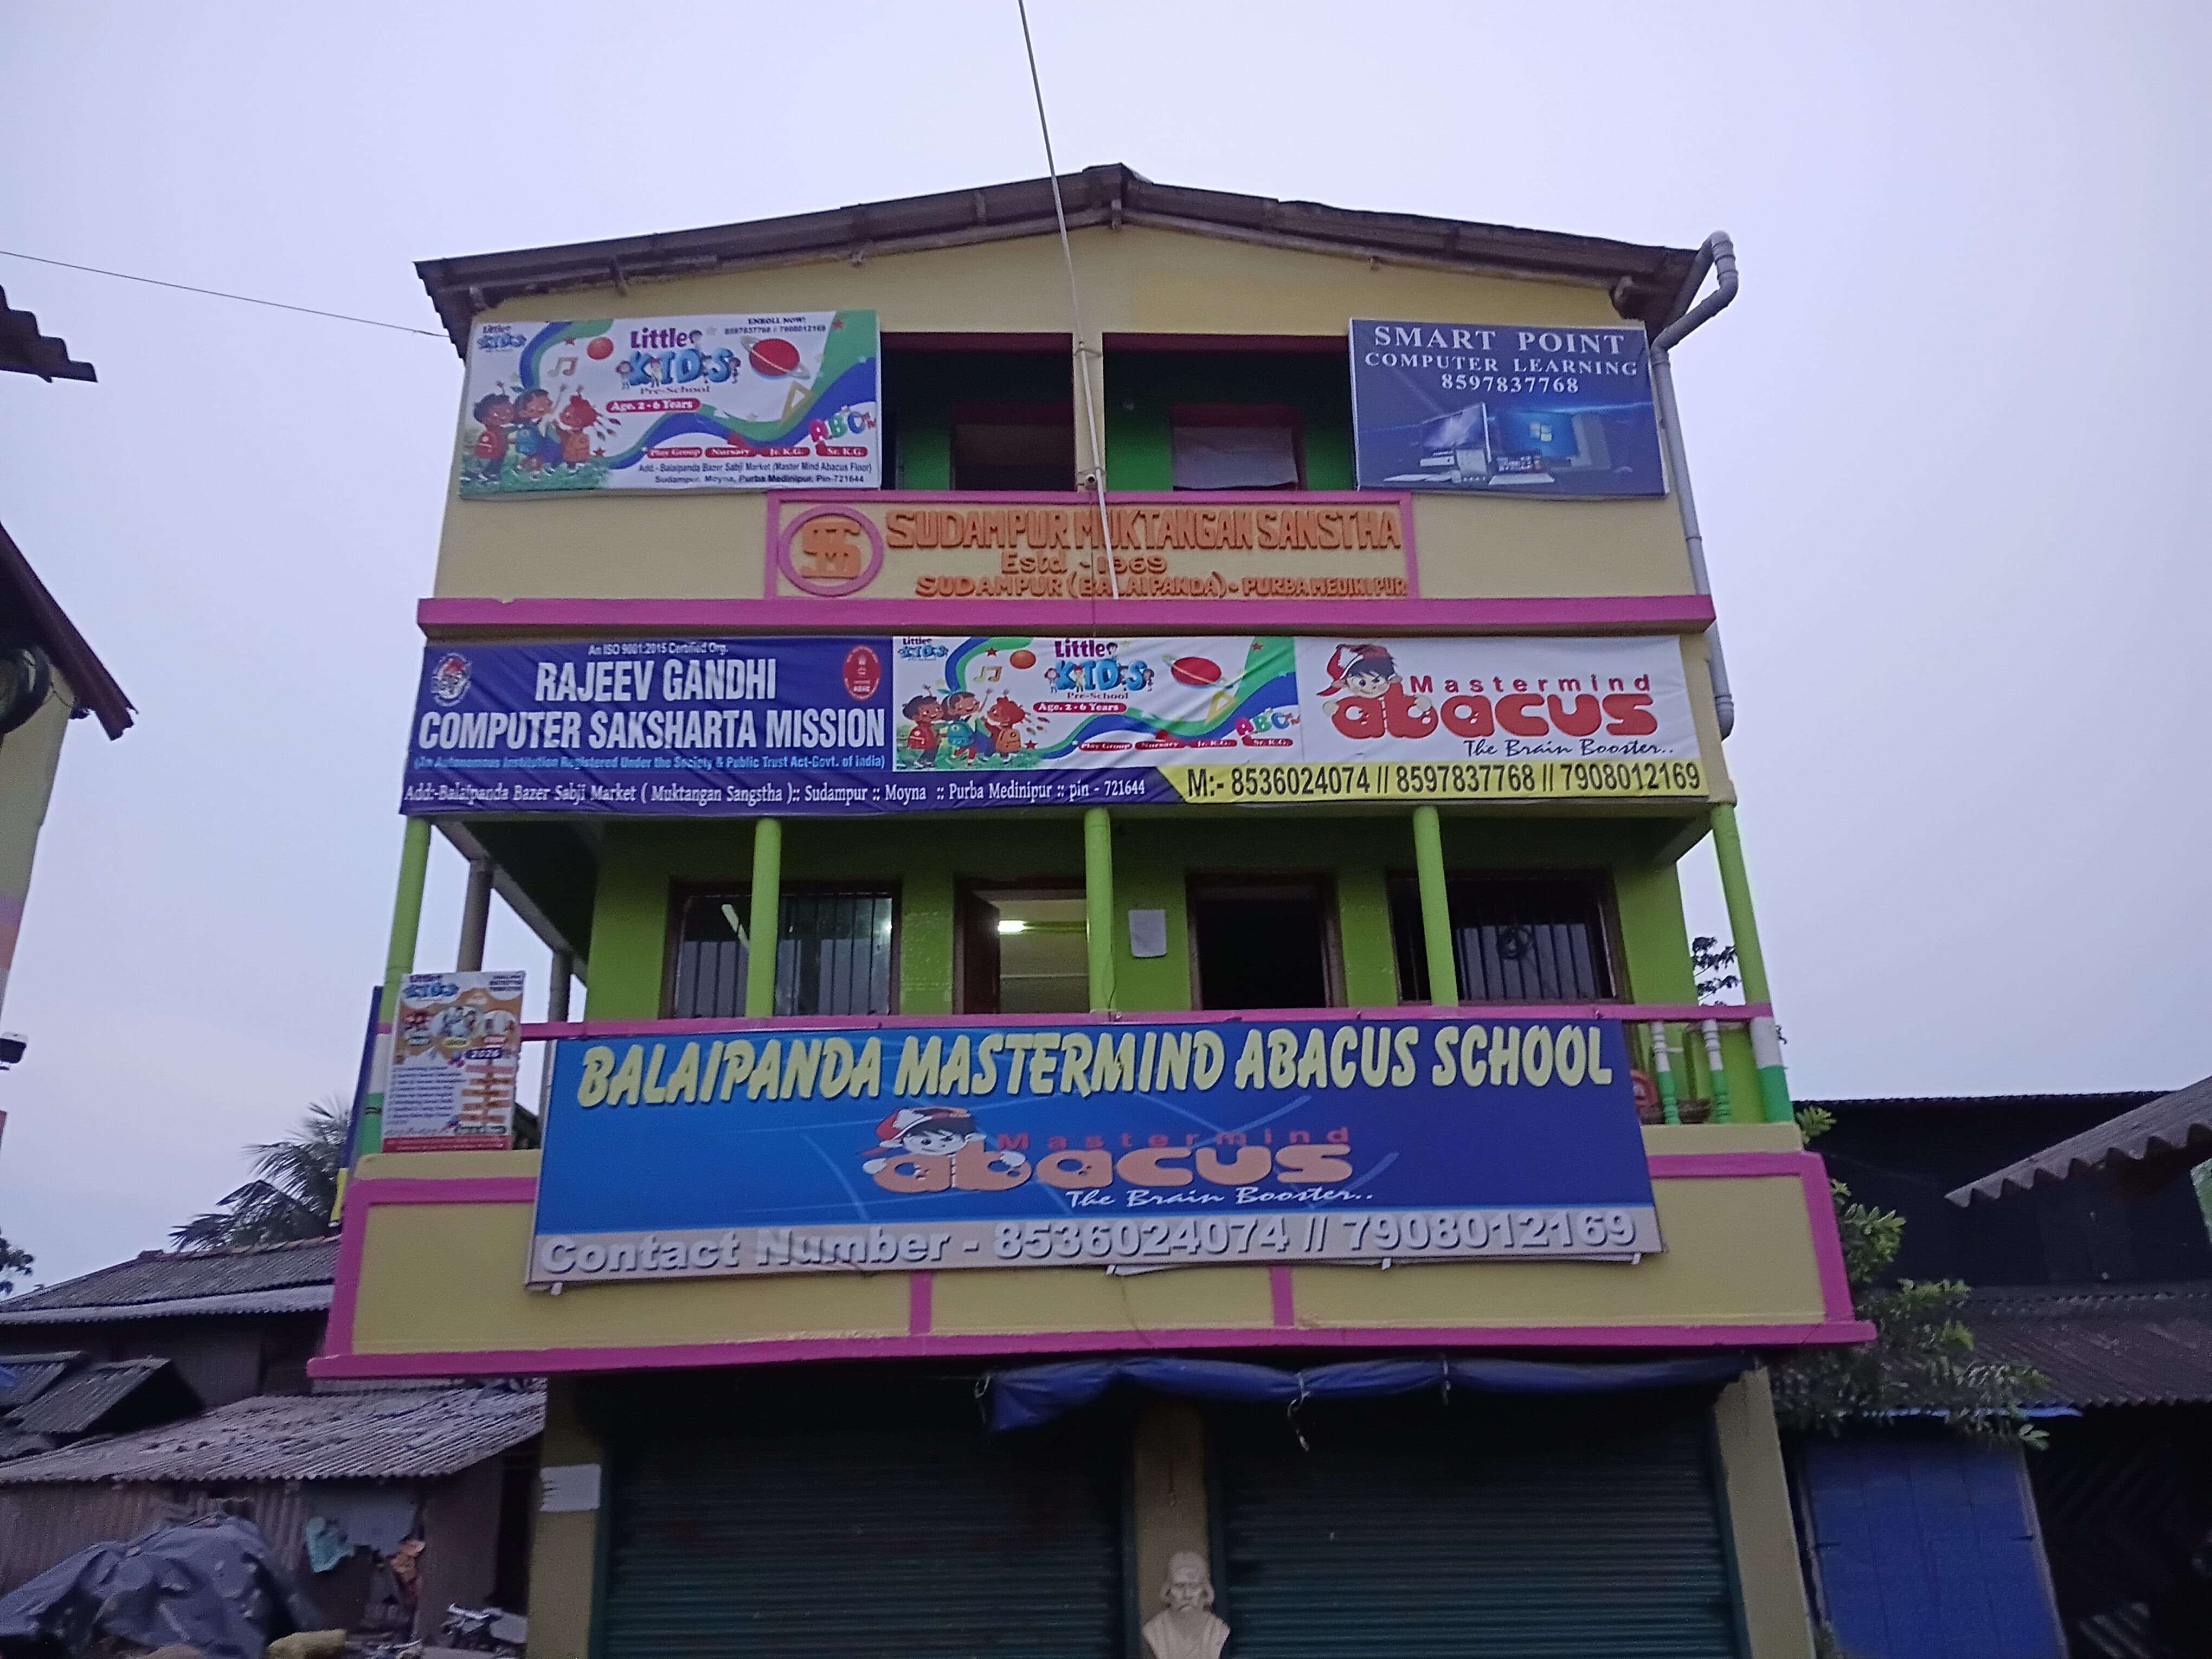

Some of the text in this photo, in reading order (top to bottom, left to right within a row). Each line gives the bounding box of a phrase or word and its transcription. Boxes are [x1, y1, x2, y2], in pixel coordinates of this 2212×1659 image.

[631, 327, 687, 349] Little
[1375, 326, 1625, 355] SMART POINT
[629, 348, 734, 385] KIDS
[1365, 352, 1638, 376] COMPUTER LEARNING
[1442, 374, 1579, 394] 8597837768
[886, 509, 1071, 550] SUDAMPUR
[1073, 509, 1253, 550] MUKTANGAN
[1257, 509, 1402, 550] SANSTHA
[915, 576, 1063, 597] SUDAMPUR
[1054, 638, 1105, 658] Little
[535, 658, 776, 703] RAJEEV GANDHI
[1056, 658, 1148, 691] KIDS
[1410, 673, 1651, 694] Mastermind
[1038, 703, 1063, 712] Age.
[1089, 702, 1119, 711] Years
[1067, 691, 1129, 700] Pre-School
[1332, 684, 1658, 740] abacus
[418, 708, 886, 751] COMPUTER SAKSHARTA MISSION
[1464, 739, 1497, 758] The
[1505, 740, 1573, 758] Brain
[512, 783, 551, 801] Bazer
[554, 782, 587, 805] Sabji
[589, 782, 638, 801] Market
[651, 783, 722, 806] Muktangan
[726, 782, 783, 807] Sangstha
[805, 781, 867, 806] Sudampur
[884, 783, 927, 806] Moyna
[948, 780, 984, 801] Purba
[988, 778, 1052, 803] Medinipur
[1069, 779, 1089, 802] pin
[1104, 779, 1146, 797] 721644
[1231, 764, 1371, 796] 8536024074
[1397, 763, 1535, 793] 8597837768
[1560, 761, 1701, 791] 7908012169
[578, 1036, 882, 1107] BALAIPANDA
[894, 1030, 1226, 1097] MASTERMIND
[1234, 1025, 1419, 1091] ABACUS
[1431, 1024, 1612, 1088] SCHOOL
[998, 1127, 1350, 1150] Mastermind
[873, 1140, 1353, 1193] abacus
[1065, 1189, 1116, 1208] The
[1126, 1189, 1225, 1208] Brain
[542, 1230, 740, 1275] Contact
[756, 1225, 950, 1269] Number
[993, 1215, 1290, 1261] 8536024074
[1342, 1209, 1637, 1250] 7908012169
